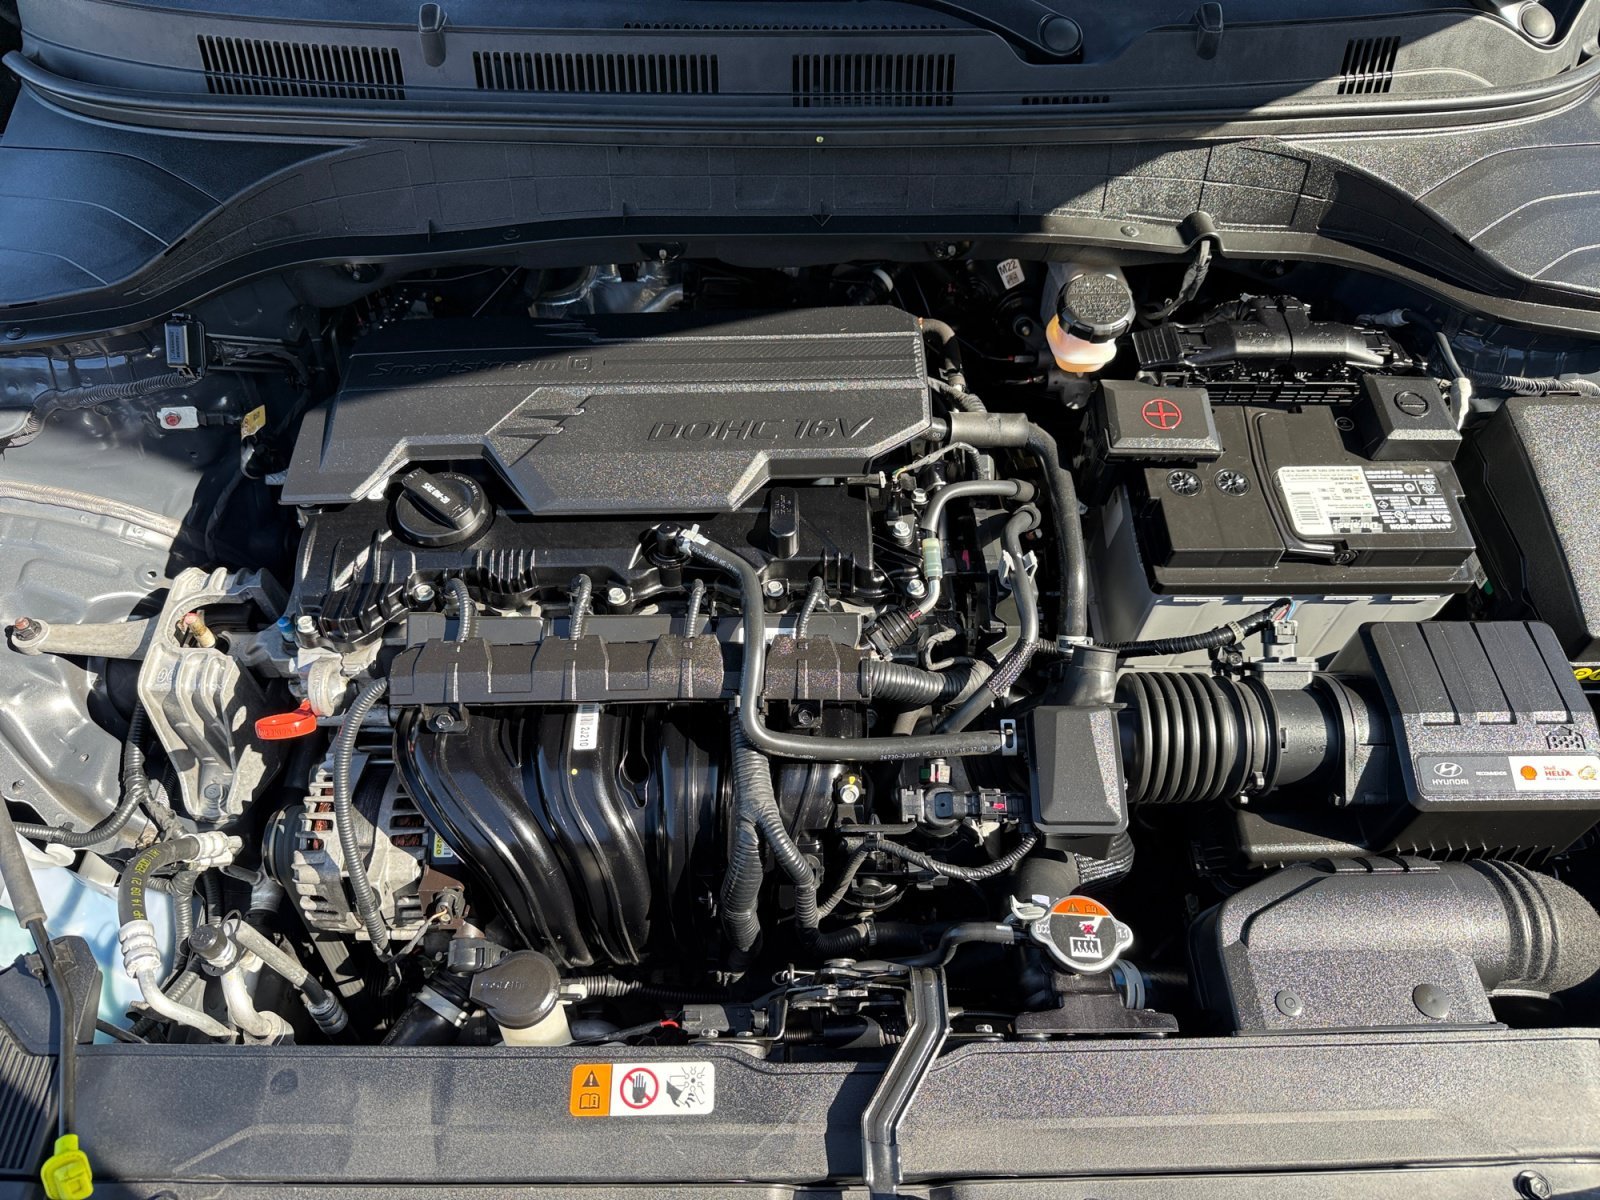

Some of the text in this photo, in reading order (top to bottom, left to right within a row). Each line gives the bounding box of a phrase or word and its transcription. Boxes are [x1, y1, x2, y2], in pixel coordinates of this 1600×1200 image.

[998, 260, 1018, 276] M22
[368, 359, 560, 378] Smartstream
[647, 417, 875, 442] DOHC 16V
[421, 482, 436, 493] SAE
[1332, 521, 1379, 531] Duralast
[1545, 769, 1574, 777] HELIX
